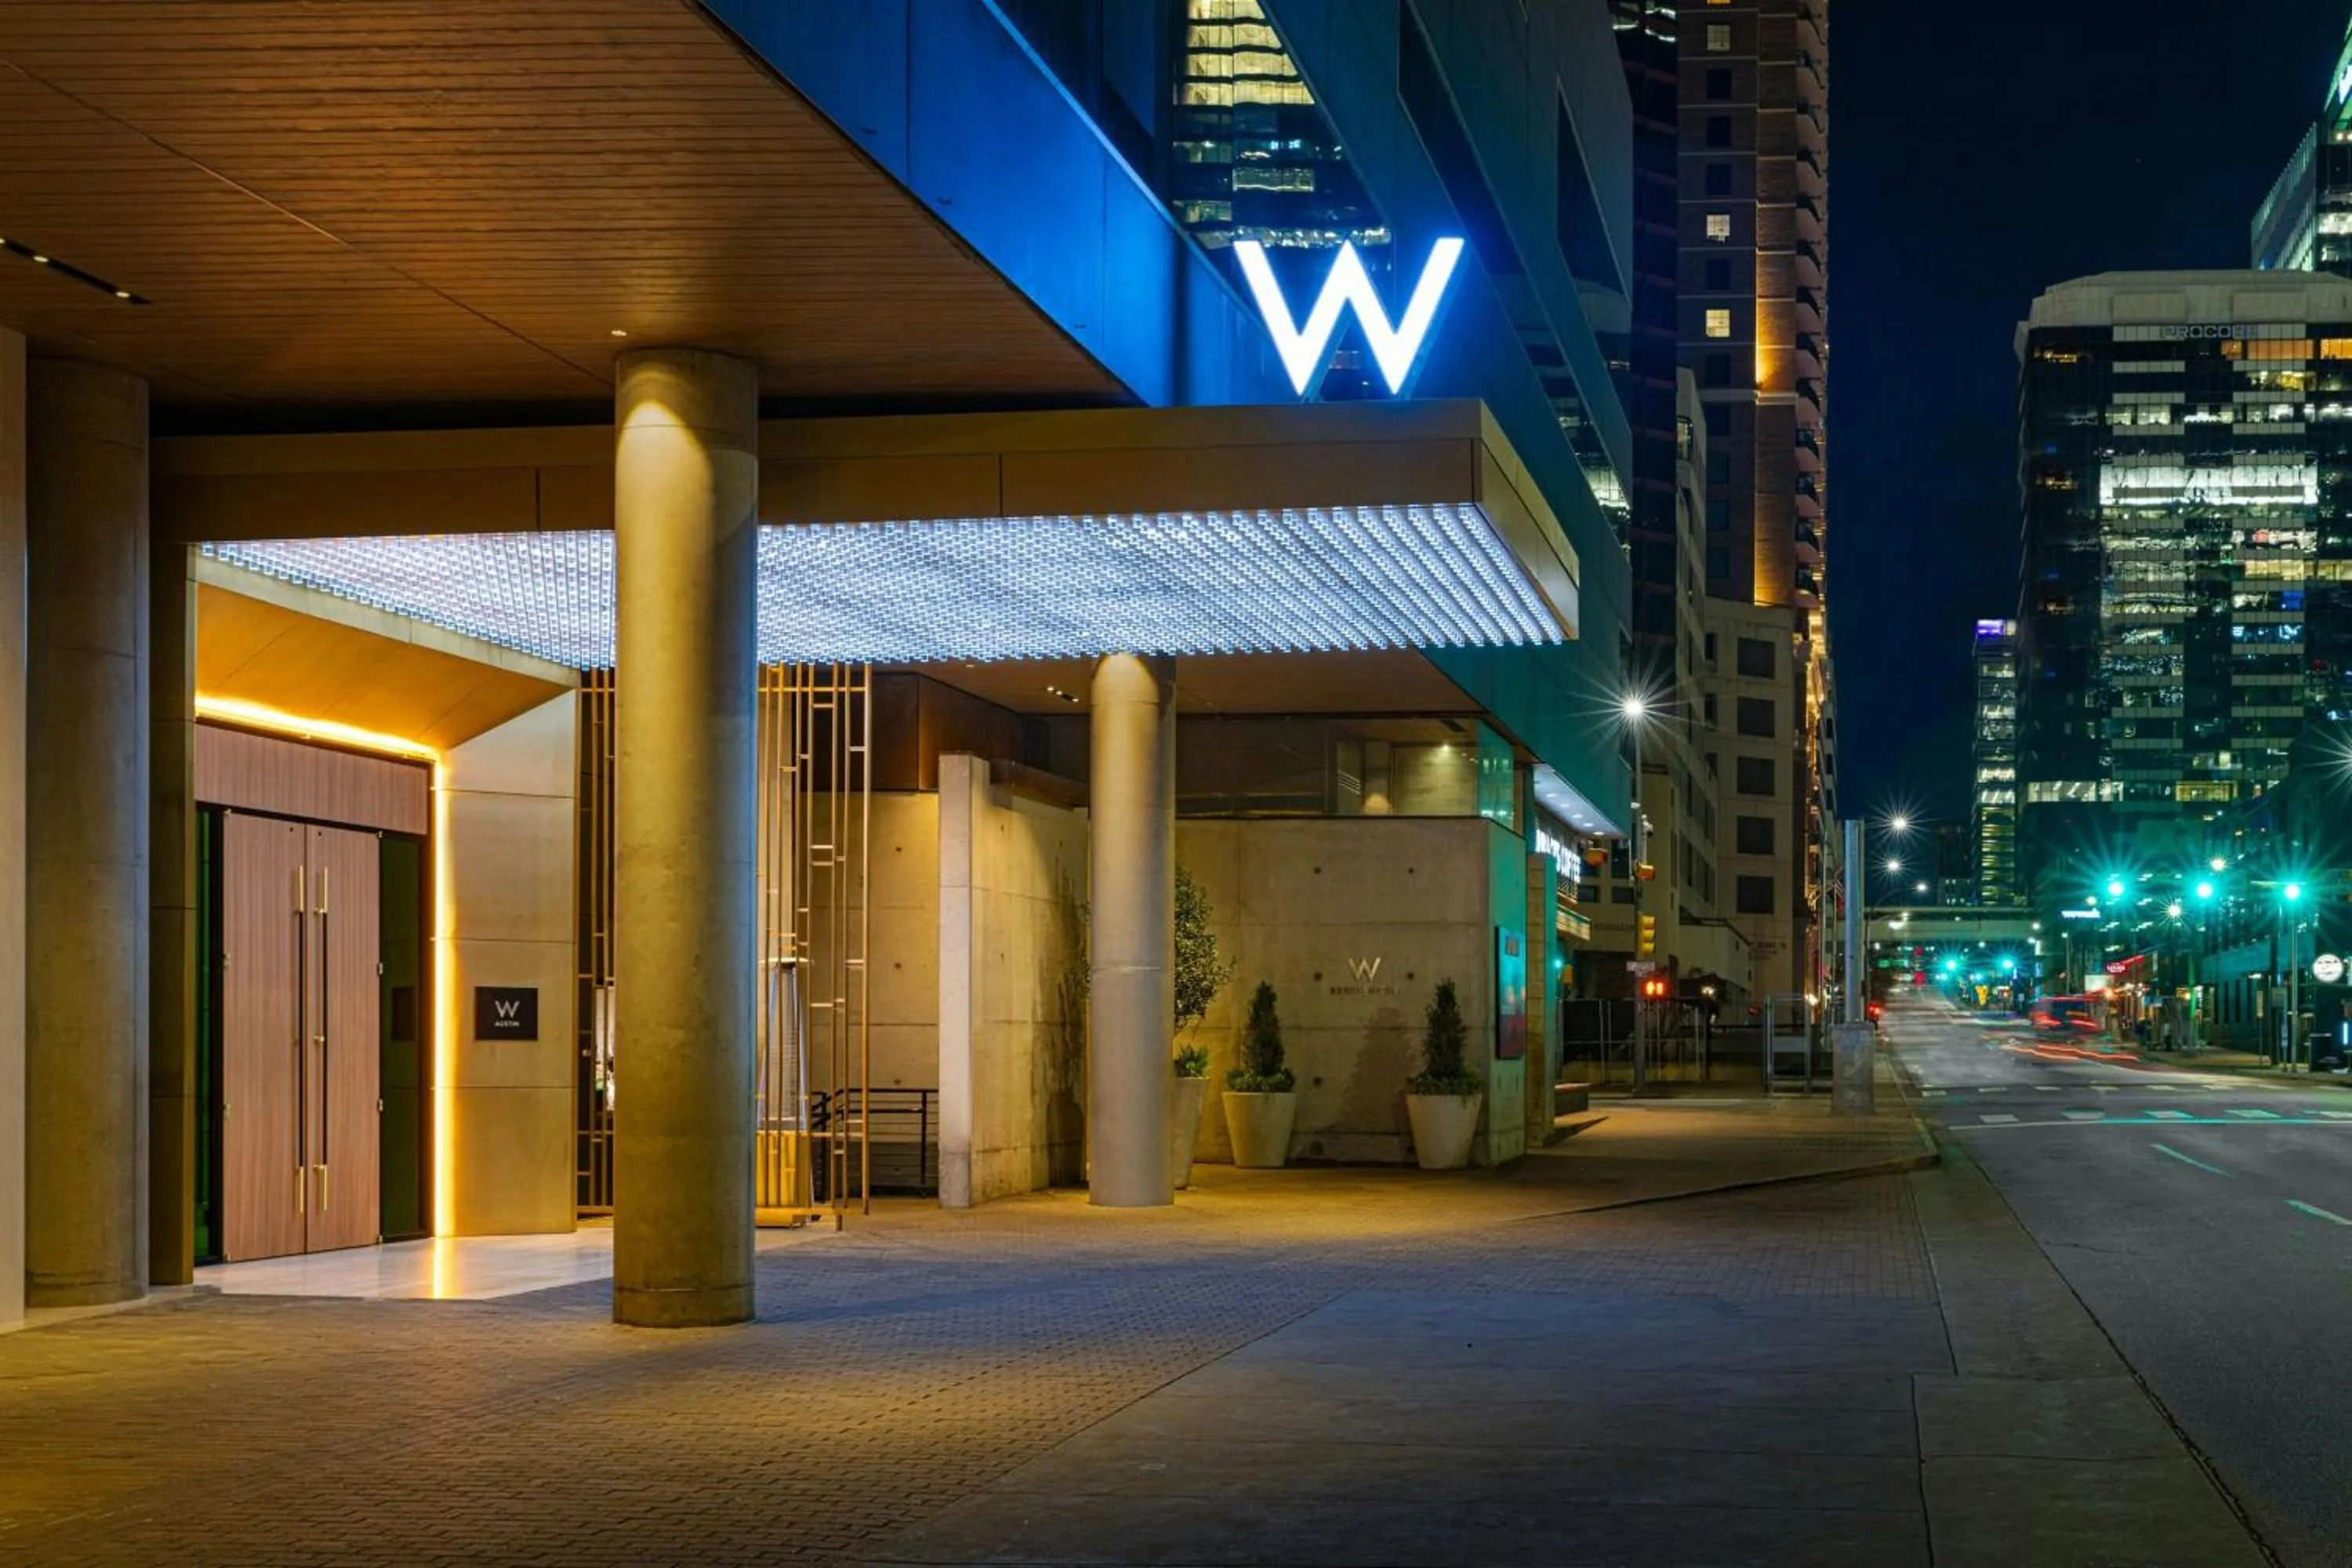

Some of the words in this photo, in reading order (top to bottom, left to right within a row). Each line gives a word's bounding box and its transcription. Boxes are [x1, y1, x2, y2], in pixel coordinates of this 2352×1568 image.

[1233, 238, 1464, 395] W
[1348, 957, 1381, 982] W
[495, 1000, 521, 1018] W
